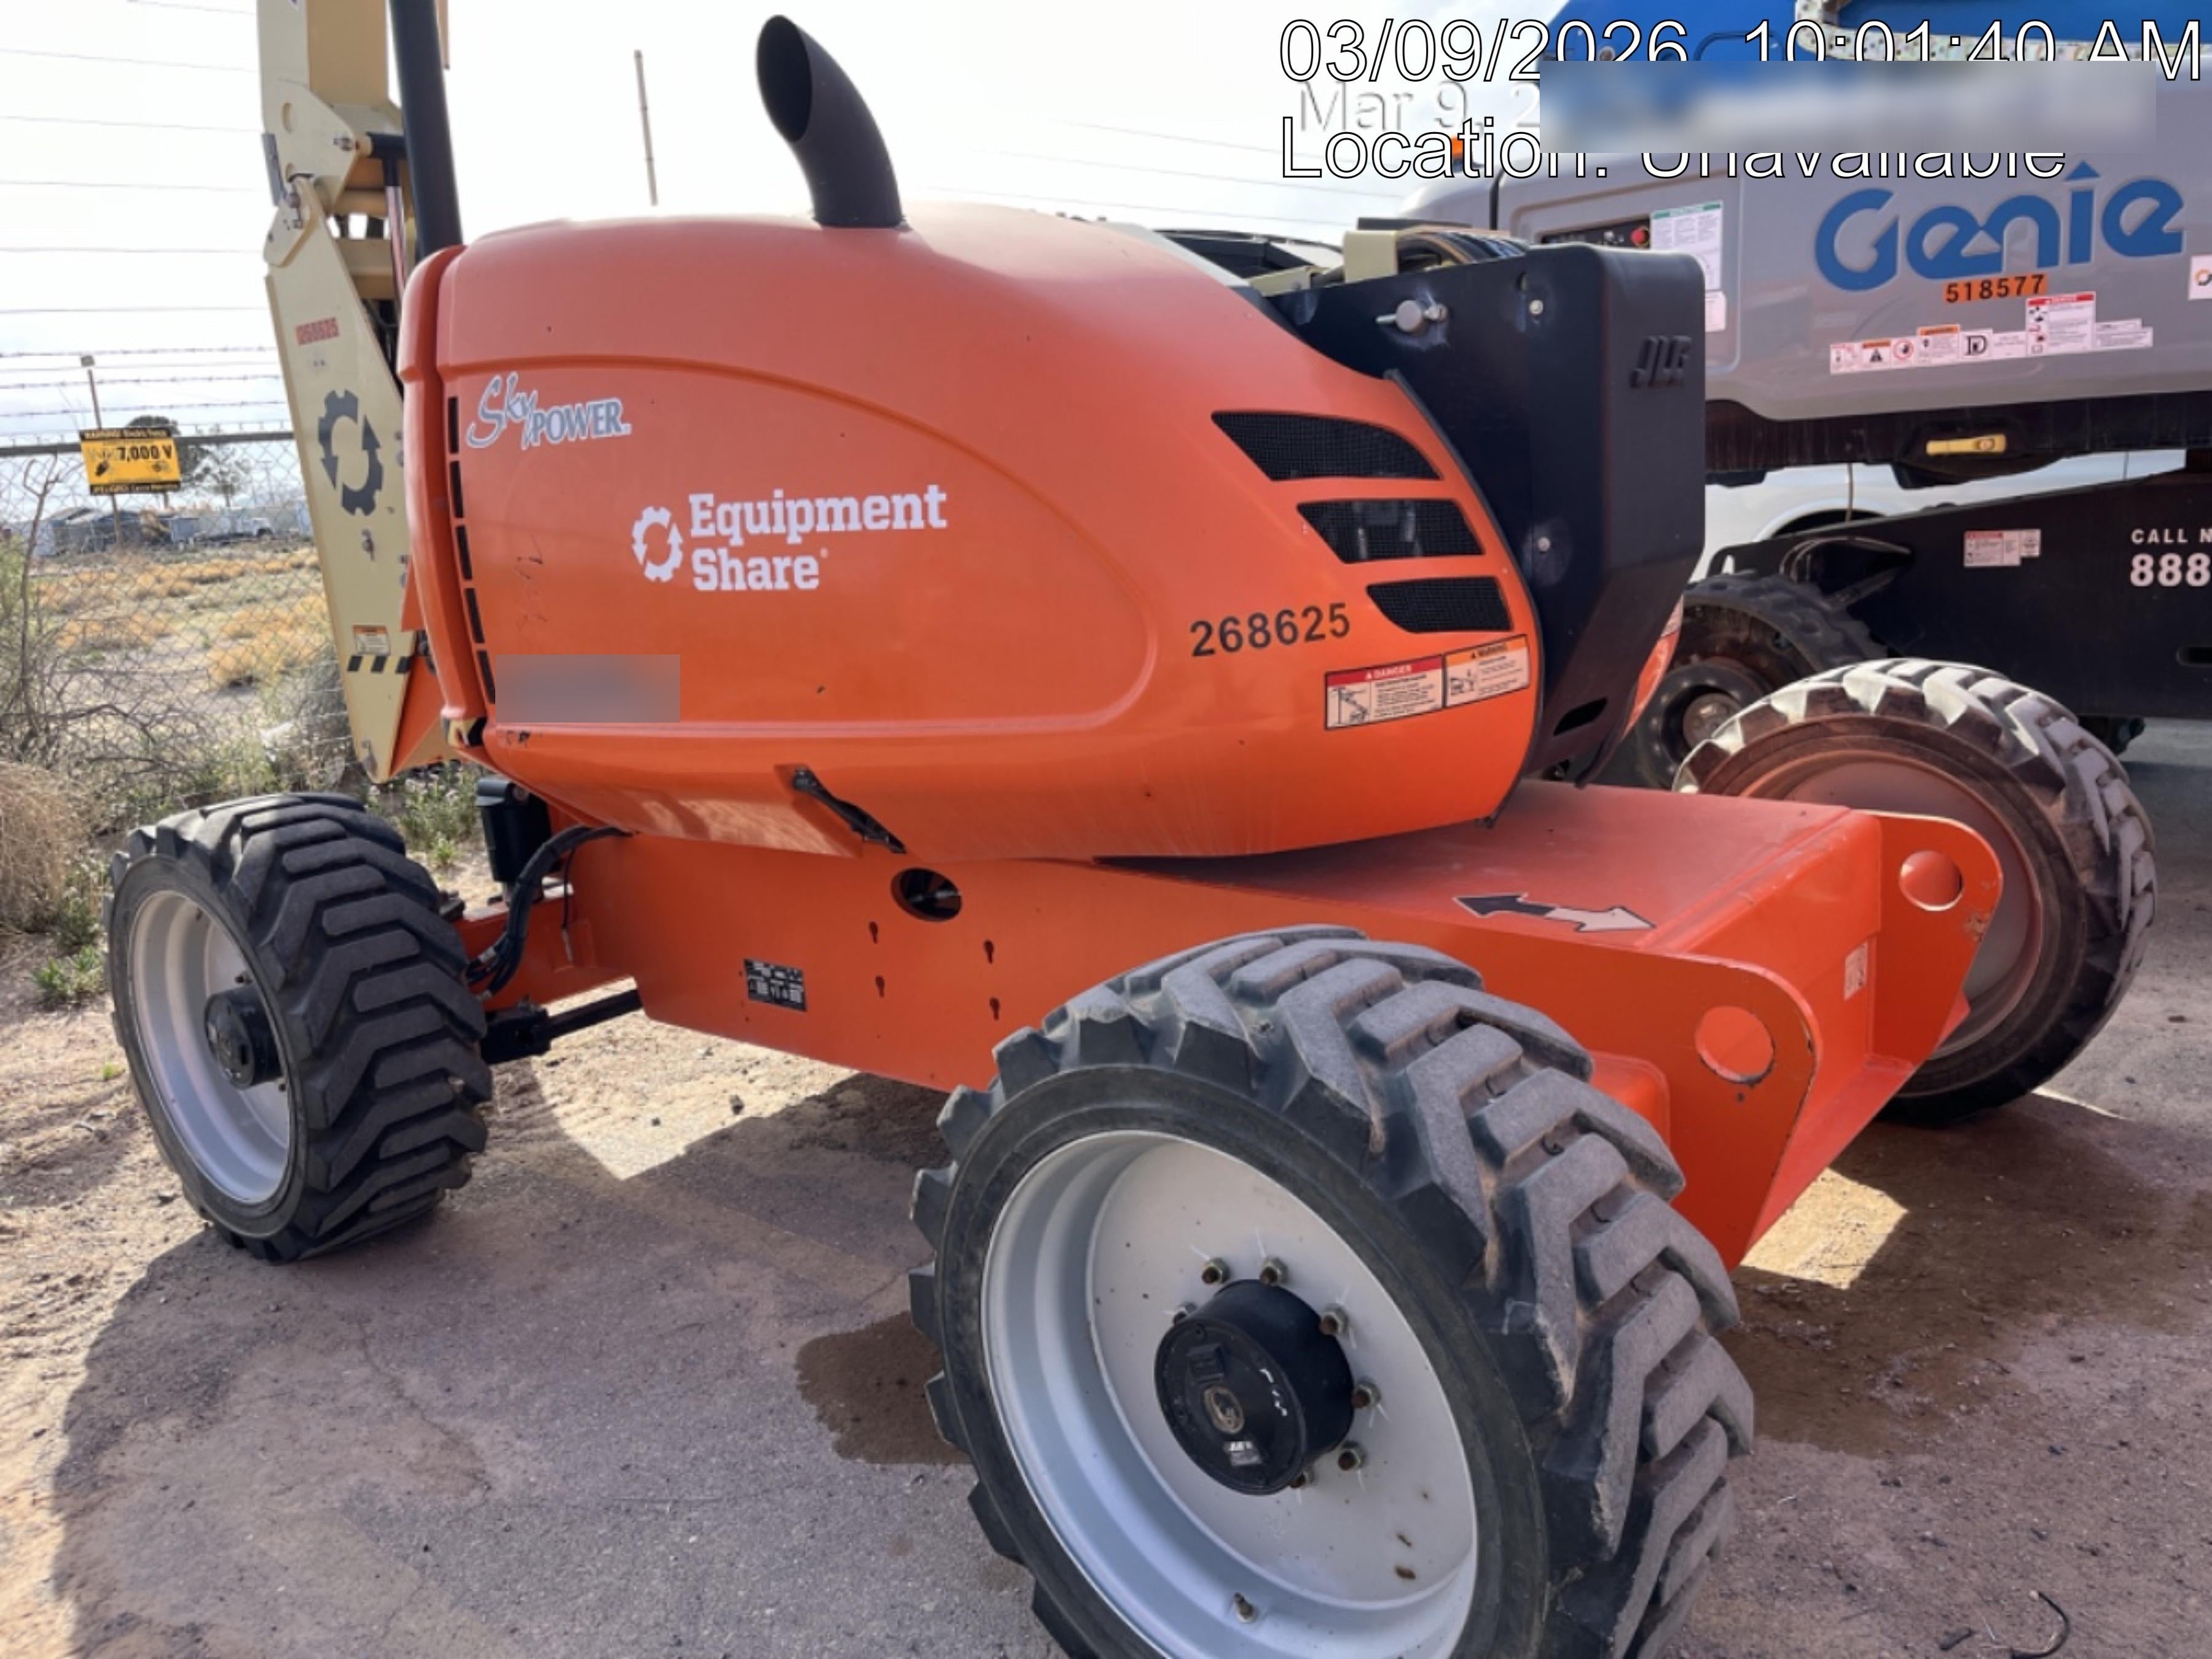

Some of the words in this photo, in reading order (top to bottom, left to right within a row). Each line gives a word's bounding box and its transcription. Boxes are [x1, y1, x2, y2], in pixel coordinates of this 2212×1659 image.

[1814, 161, 2184, 292] Genie
[1945, 274, 2044, 303] 518577
[116, 445, 160, 463] 7,000
[162, 444, 173, 460] V
[689, 485, 947, 546] Equipment
[2130, 528, 2189, 544] CALL
[691, 547, 819, 590] Share
[1190, 602, 1351, 657] 268625
